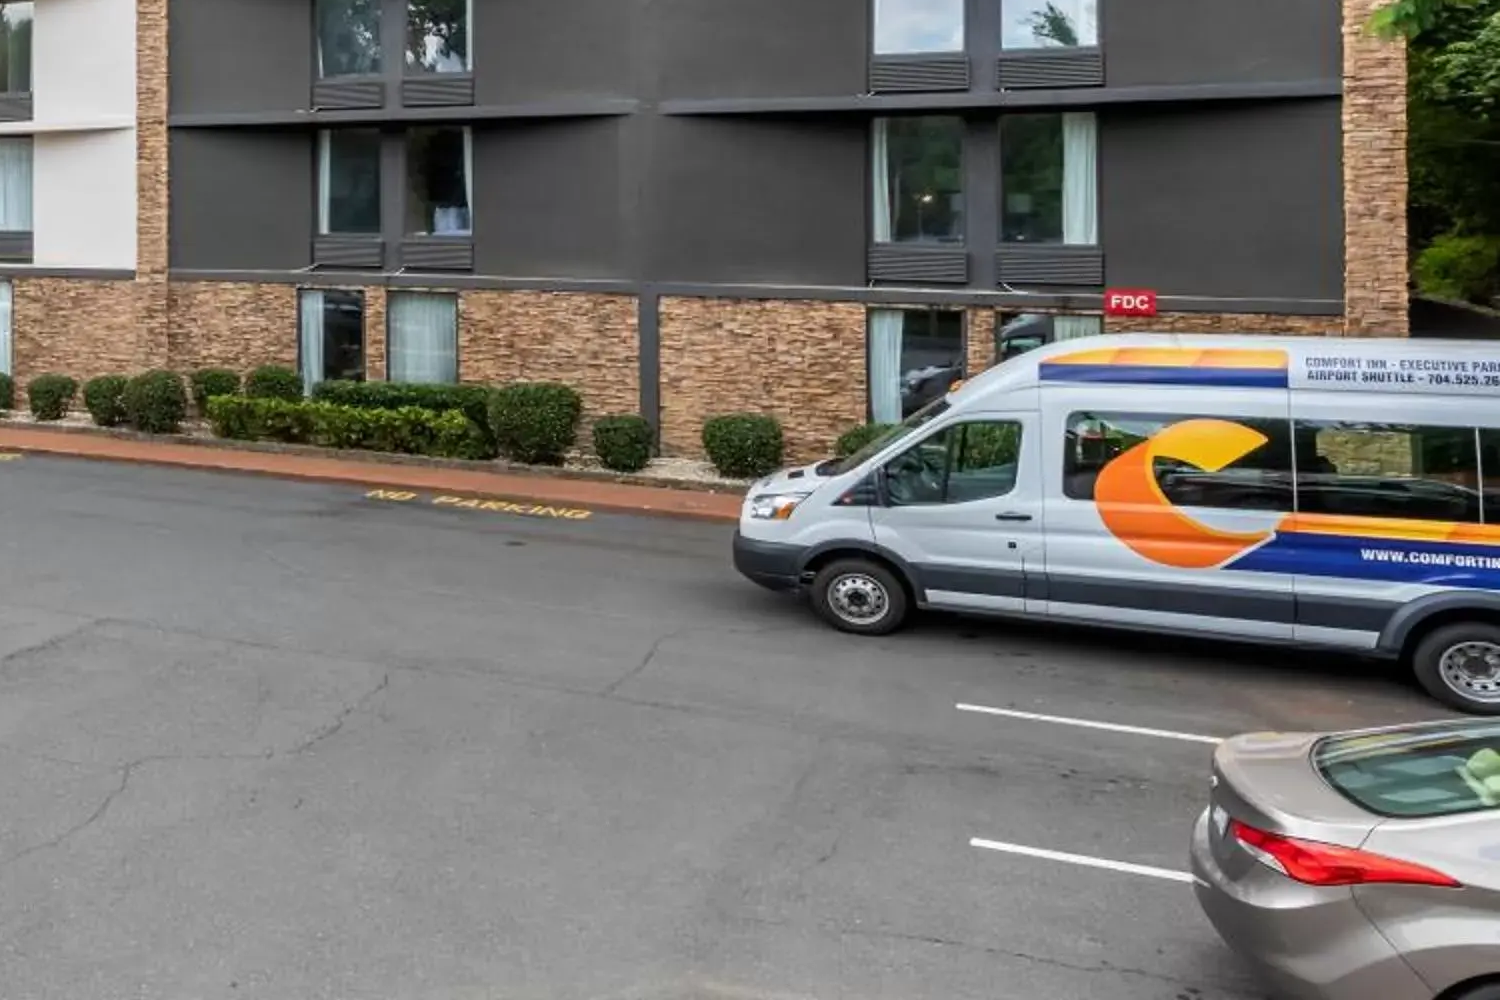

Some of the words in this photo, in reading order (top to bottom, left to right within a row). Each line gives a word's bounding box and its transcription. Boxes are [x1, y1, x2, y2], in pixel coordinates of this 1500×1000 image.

[1111, 295, 1149, 310] FDC
[1305, 357, 1362, 370] COMFORT
[1400, 360, 1469, 372] EXECUTIVE
[1472, 361, 1500, 373] PAR
[1307, 370, 1357, 383] AIRPORT
[1362, 371, 1414, 384] SHUTTLE
[366, 489, 417, 501] NO
[432, 496, 594, 519] PARKING
